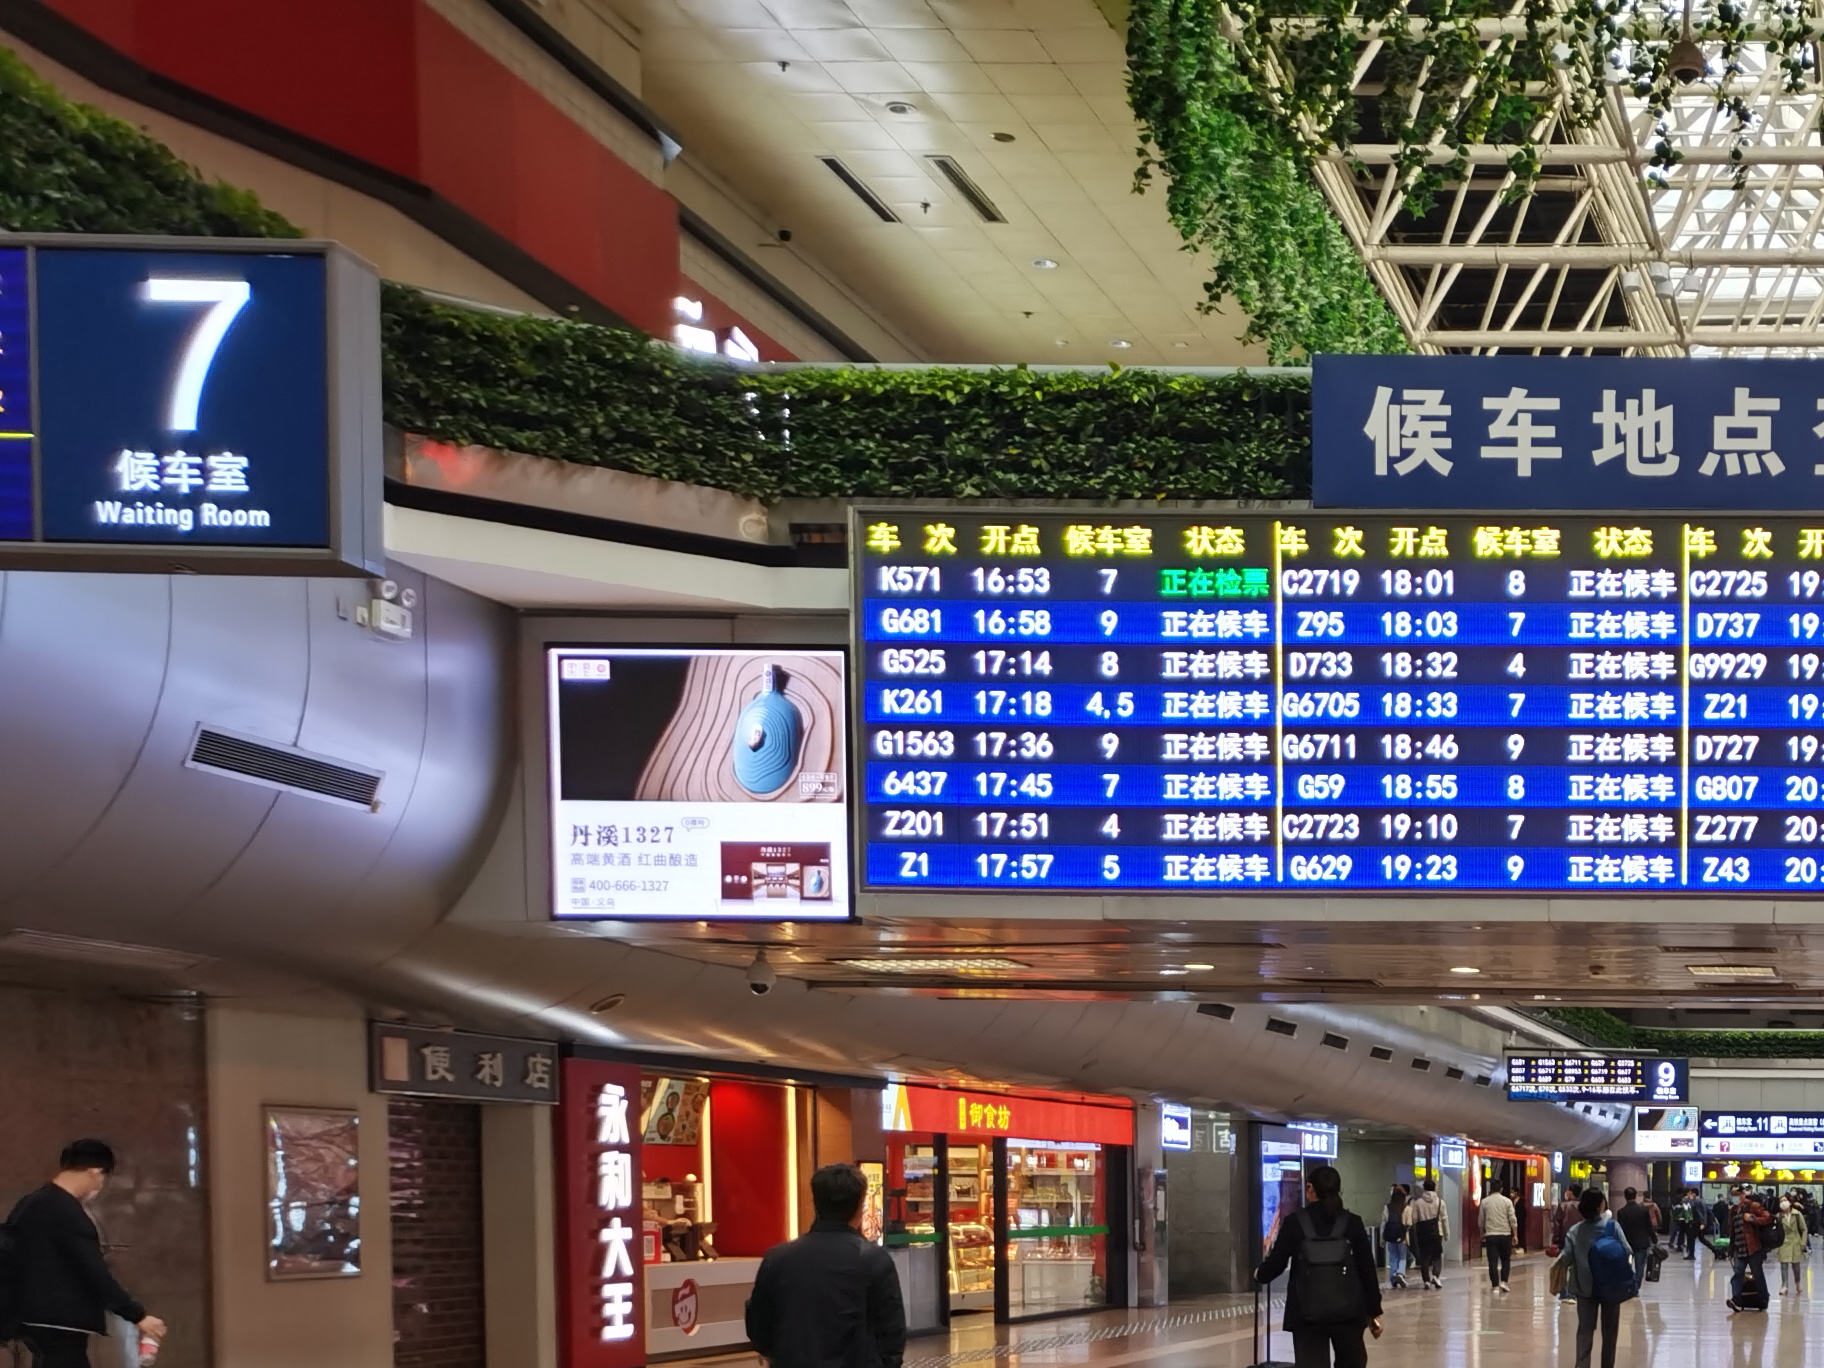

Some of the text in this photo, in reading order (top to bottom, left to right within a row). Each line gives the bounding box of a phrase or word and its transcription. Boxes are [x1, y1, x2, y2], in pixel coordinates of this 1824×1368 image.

[144, 278, 251, 432] 7
[117, 449, 250, 493] 候车室
[95, 500, 270, 531] Waiting Room
[981, 525, 1040, 555] 开点
[1063, 525, 1152, 556] 候车室
[1184, 526, 1245, 557] 状态
[1390, 527, 1448, 557] 开点
[1472, 527, 1560, 558] 候车室
[1593, 527, 1653, 558] 状态
[879, 566, 1269, 597] K571 16:53 7 正在检票
[1282, 568, 1677, 598] C2719 18:01 8 正在候车
[1689, 570, 1767, 597] C2725
[881, 608, 1269, 638] G681 16:58 9 正在候车
[1297, 610, 1676, 639] Z95 18:03 7 正在候车
[1697, 612, 1760, 638] D737
[882, 649, 1270, 678] G525 17:14 8 正在候车
[1290, 651, 1676, 679] D733 18:32 4 正在候车
[1688, 653, 1767, 679] G9929
[882, 688, 1051, 716] K261 17:18
[1282, 692, 1457, 718] G6705 18:33
[1704, 693, 1746, 719] Z21
[875, 730, 1053, 758] G1563 17:36
[1282, 734, 1458, 759] G6711 18:46
[1696, 735, 1759, 760] D727
[884, 771, 1053, 798] 6437 17:45
[1298, 774, 1457, 799] G59 18:55
[1695, 775, 1758, 801] G807
[884, 810, 1048, 838] Z201 17:51
[1282, 813, 1457, 839] C2723 19:10
[1695, 815, 1758, 841] Z277
[900, 852, 1053, 879] Z1 17:57
[1290, 855, 1457, 881] G629 19:23
[1702, 857, 1749, 883] Z43
[588, 879, 669, 892] 400-666-1327
[420, 1044, 553, 1091] 便利店
[1657, 1061, 1675, 1087] 9
[969, 1102, 1011, 1130] 御食坊
[1756, 1117, 1769, 1131] 11
[598, 1084, 635, 1342] 永和大王
